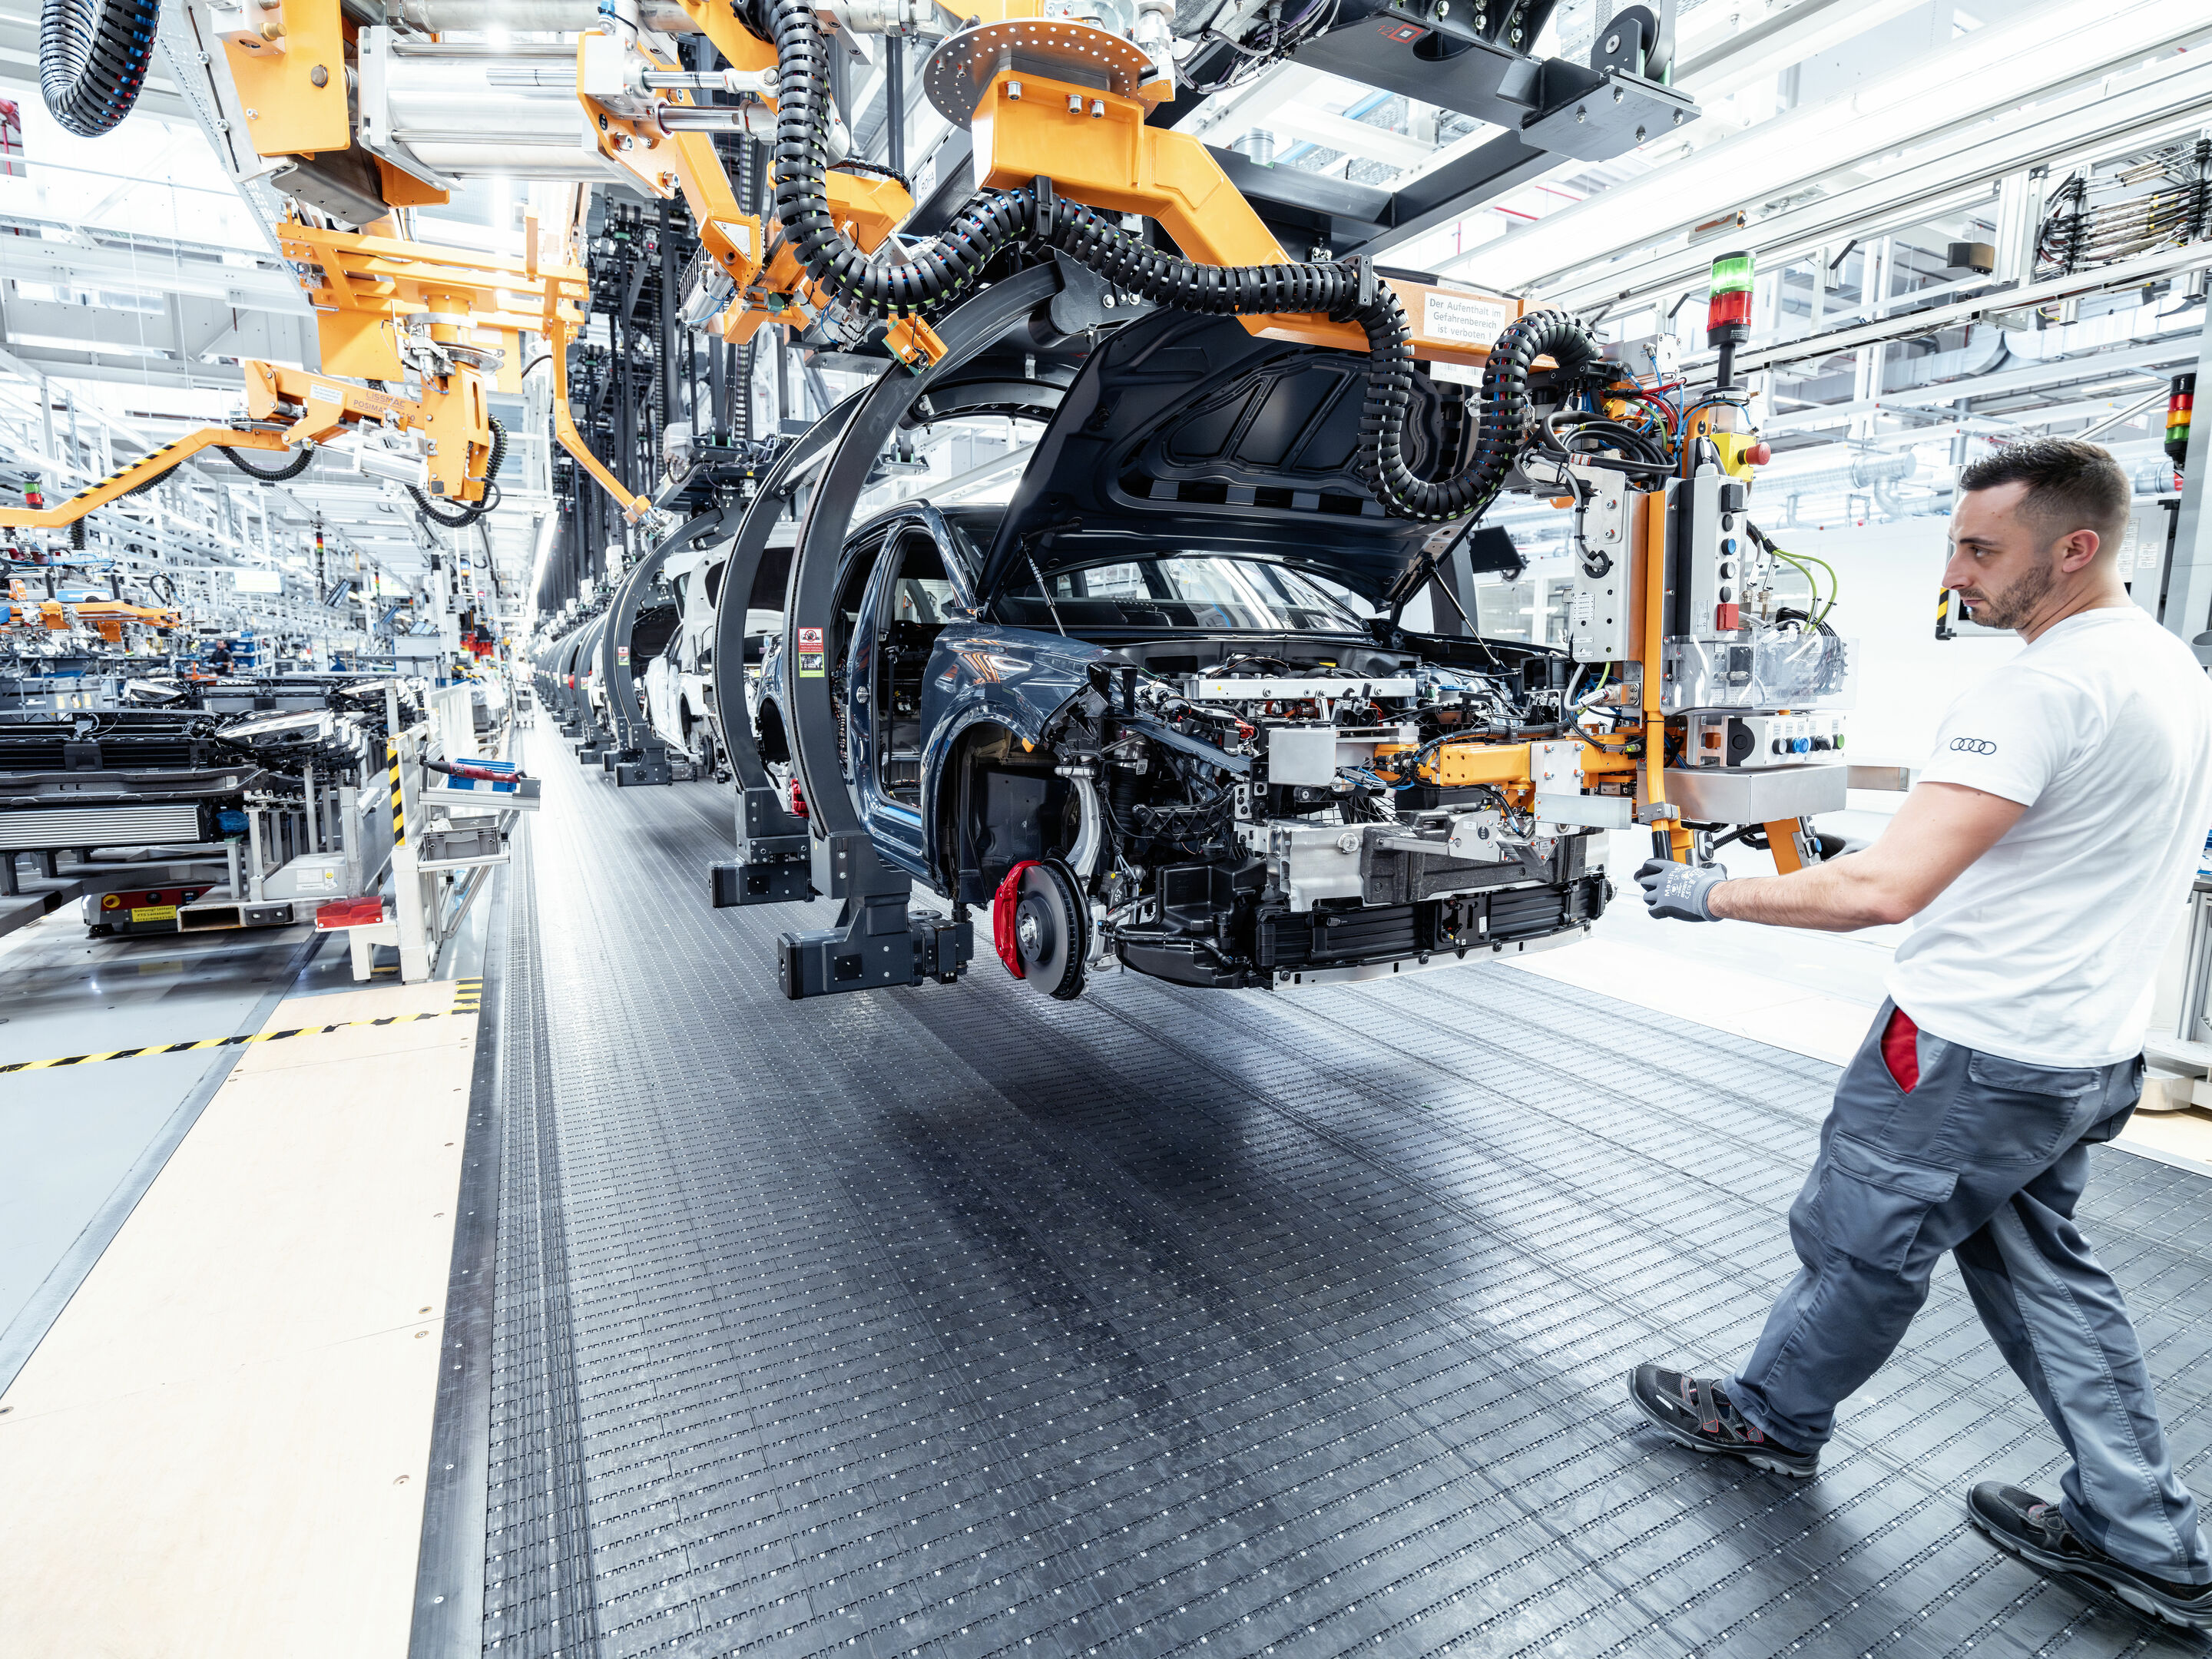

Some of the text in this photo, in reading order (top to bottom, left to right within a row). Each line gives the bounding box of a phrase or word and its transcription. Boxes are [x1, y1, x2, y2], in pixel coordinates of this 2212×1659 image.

[1376, 25, 1395, 35] 12
[1429, 298, 1502, 318] Der Aufenthalt im
[1433, 311, 1497, 329] Gefahrenbereich
[1437, 323, 1447, 333] ist
[1450, 327, 1485, 339] verboten
[366, 391, 406, 408] LISSMAC
